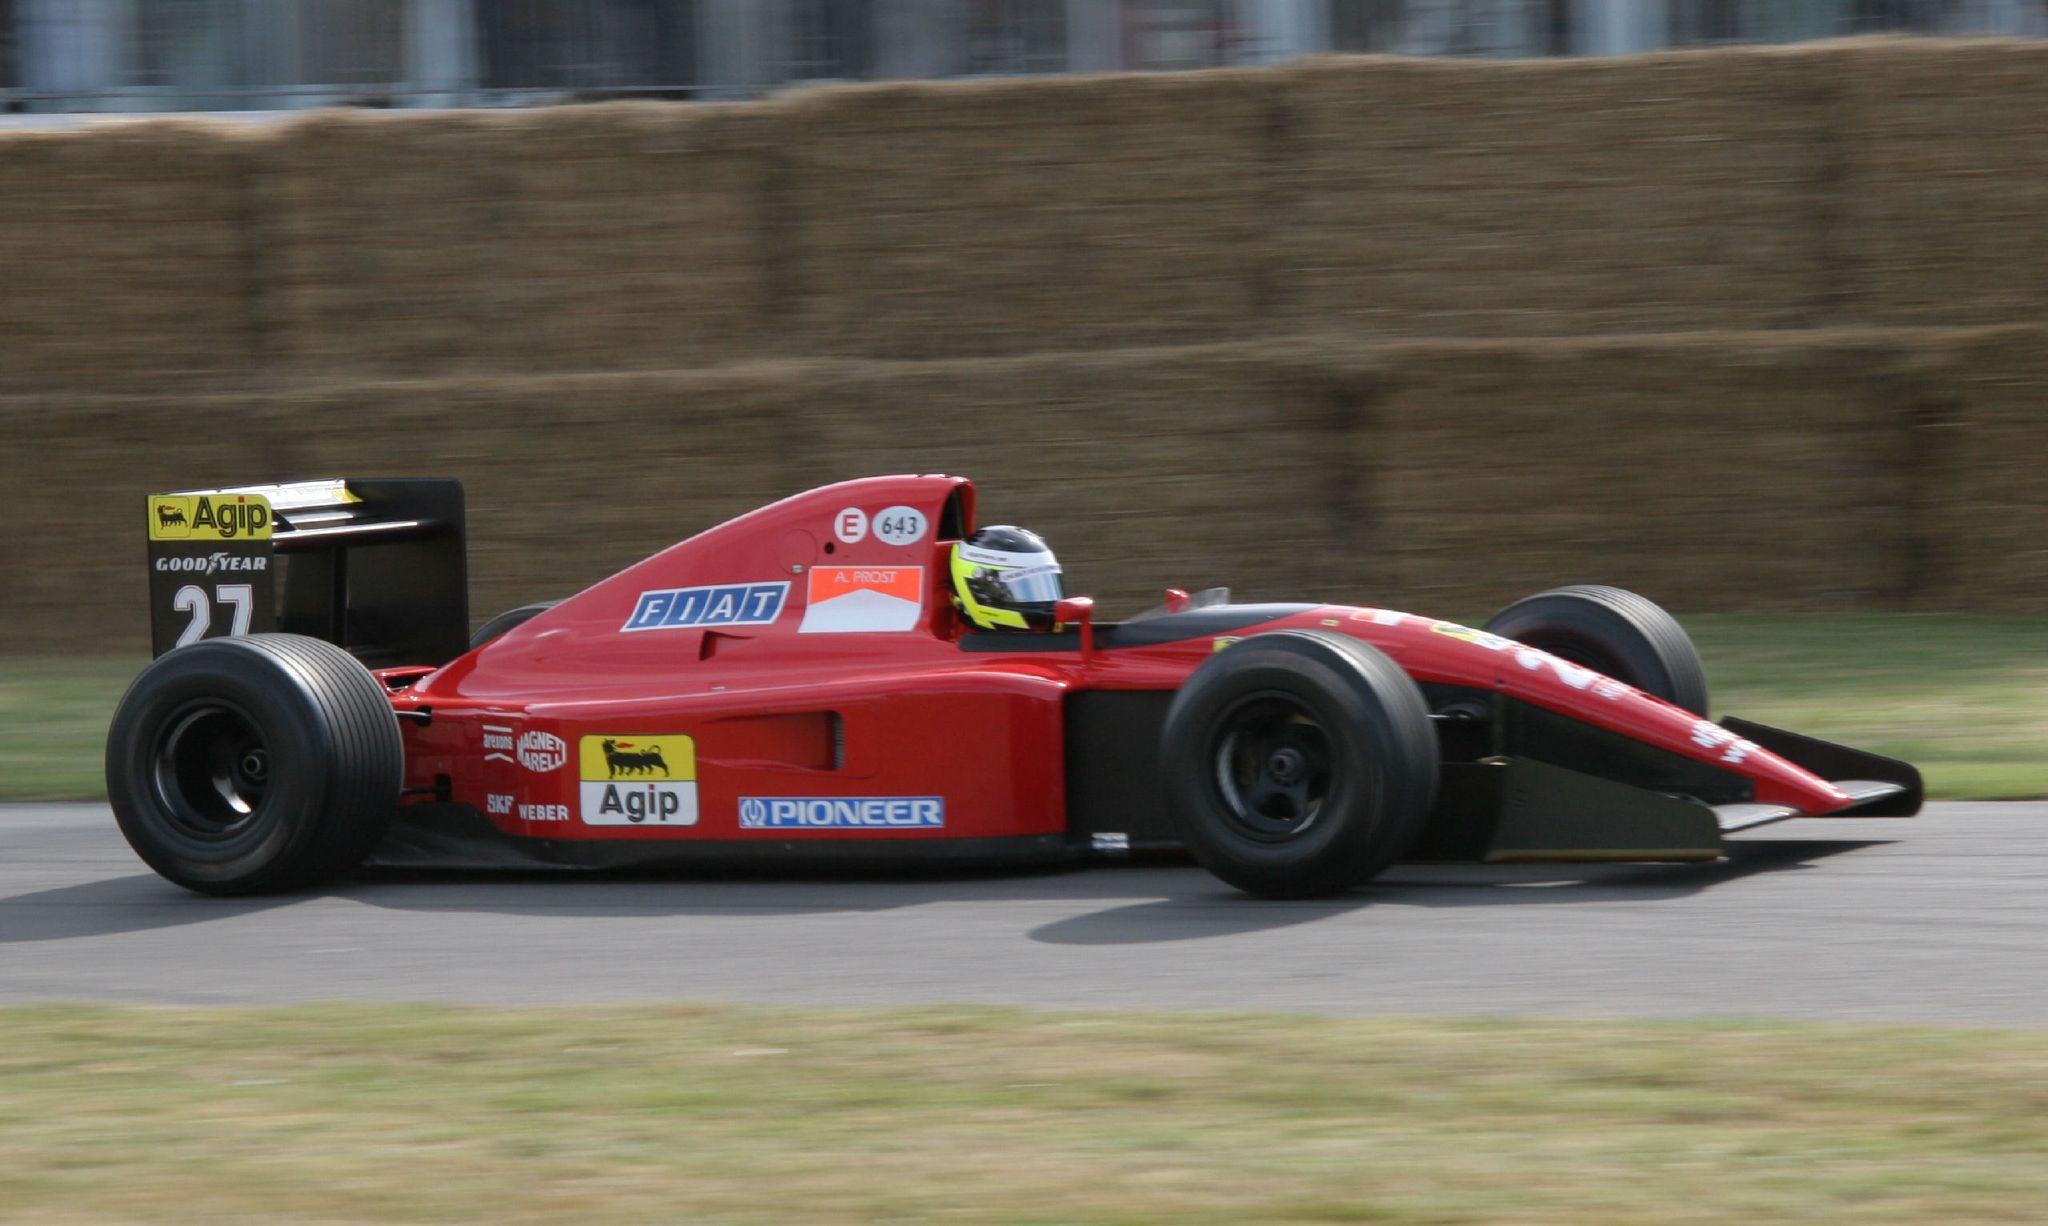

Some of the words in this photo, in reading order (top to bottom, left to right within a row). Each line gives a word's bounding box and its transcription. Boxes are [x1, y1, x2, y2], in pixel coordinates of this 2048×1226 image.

[191, 496, 268, 537] Agip
[842, 513, 860, 537] E
[881, 515, 918, 535] 643
[852, 570, 897, 584] PROST
[173, 584, 253, 649] 27
[638, 591, 779, 624] FIAT
[487, 793, 514, 814] SKF
[518, 803, 569, 821] WEBER
[599, 783, 680, 823] Agip
[771, 799, 943, 826] PIONEER
